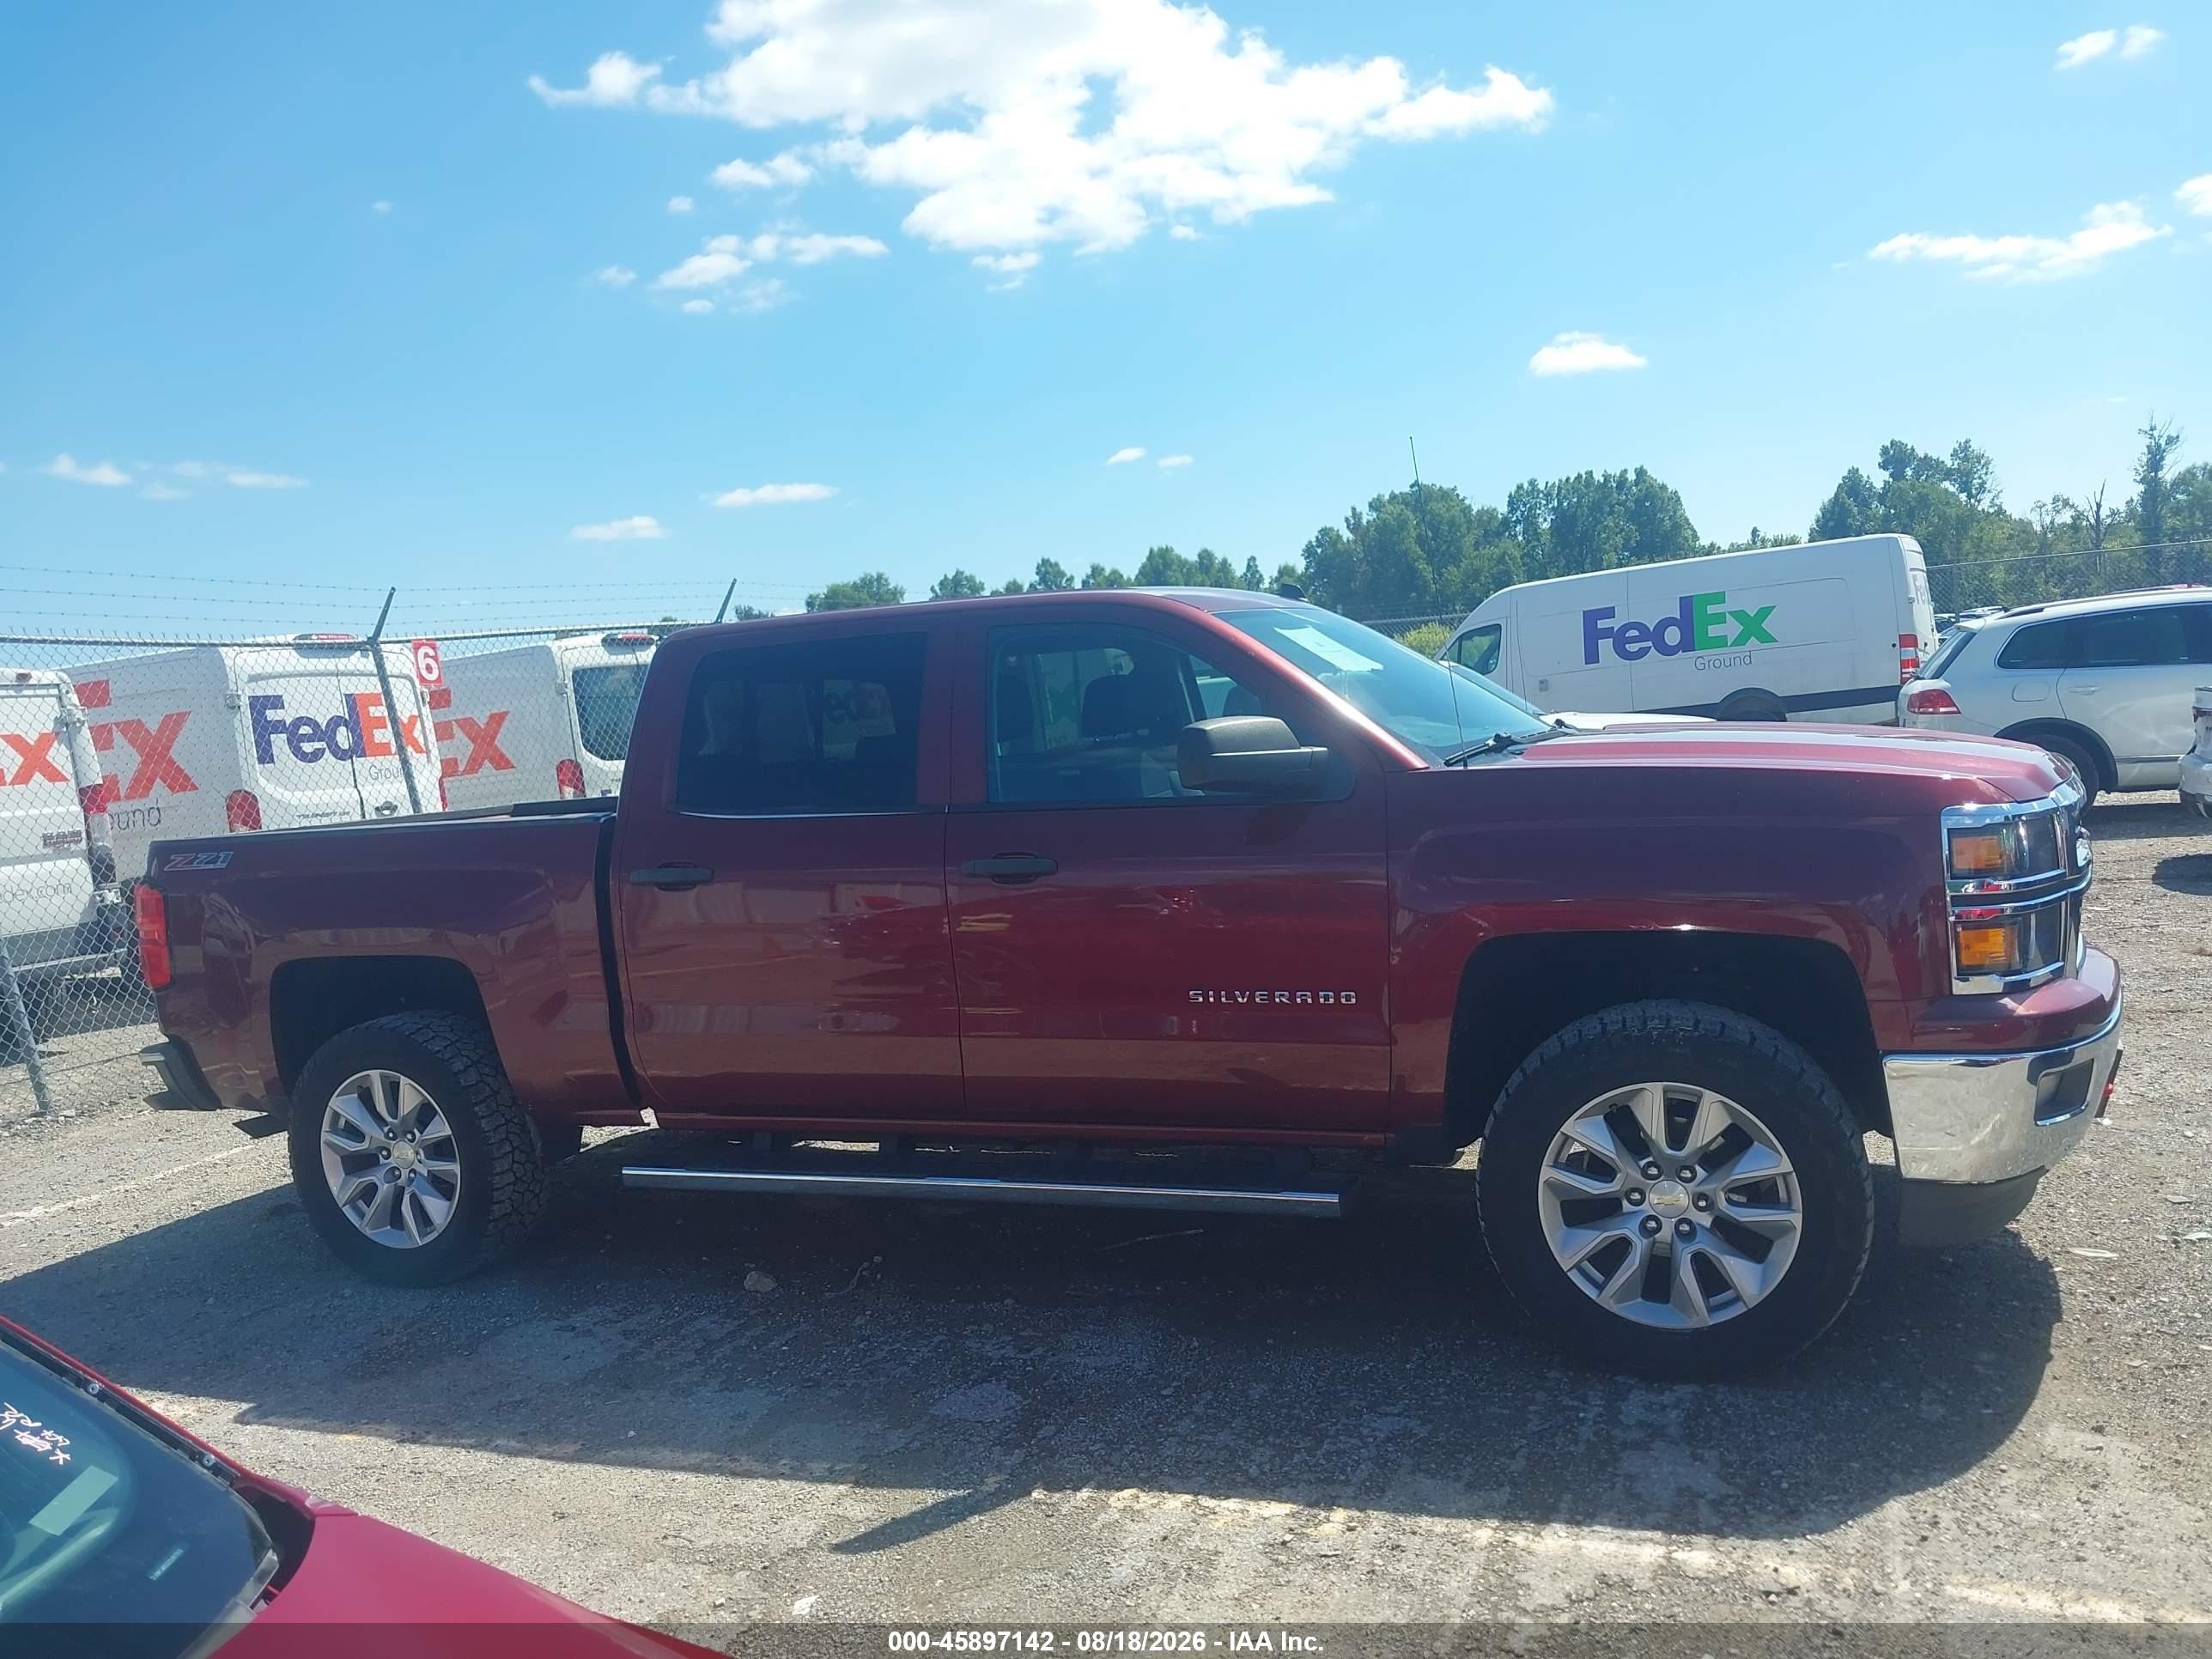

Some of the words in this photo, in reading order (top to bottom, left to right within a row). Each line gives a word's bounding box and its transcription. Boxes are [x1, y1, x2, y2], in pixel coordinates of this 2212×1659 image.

[1583, 591, 1778, 665] FedEx
[417, 646, 440, 681] 6
[1694, 652, 1753, 671] Ground
[248, 692, 427, 765] FedEx
[163, 851, 234, 872] Z71
[1188, 990, 1357, 1004] SILVERADO
